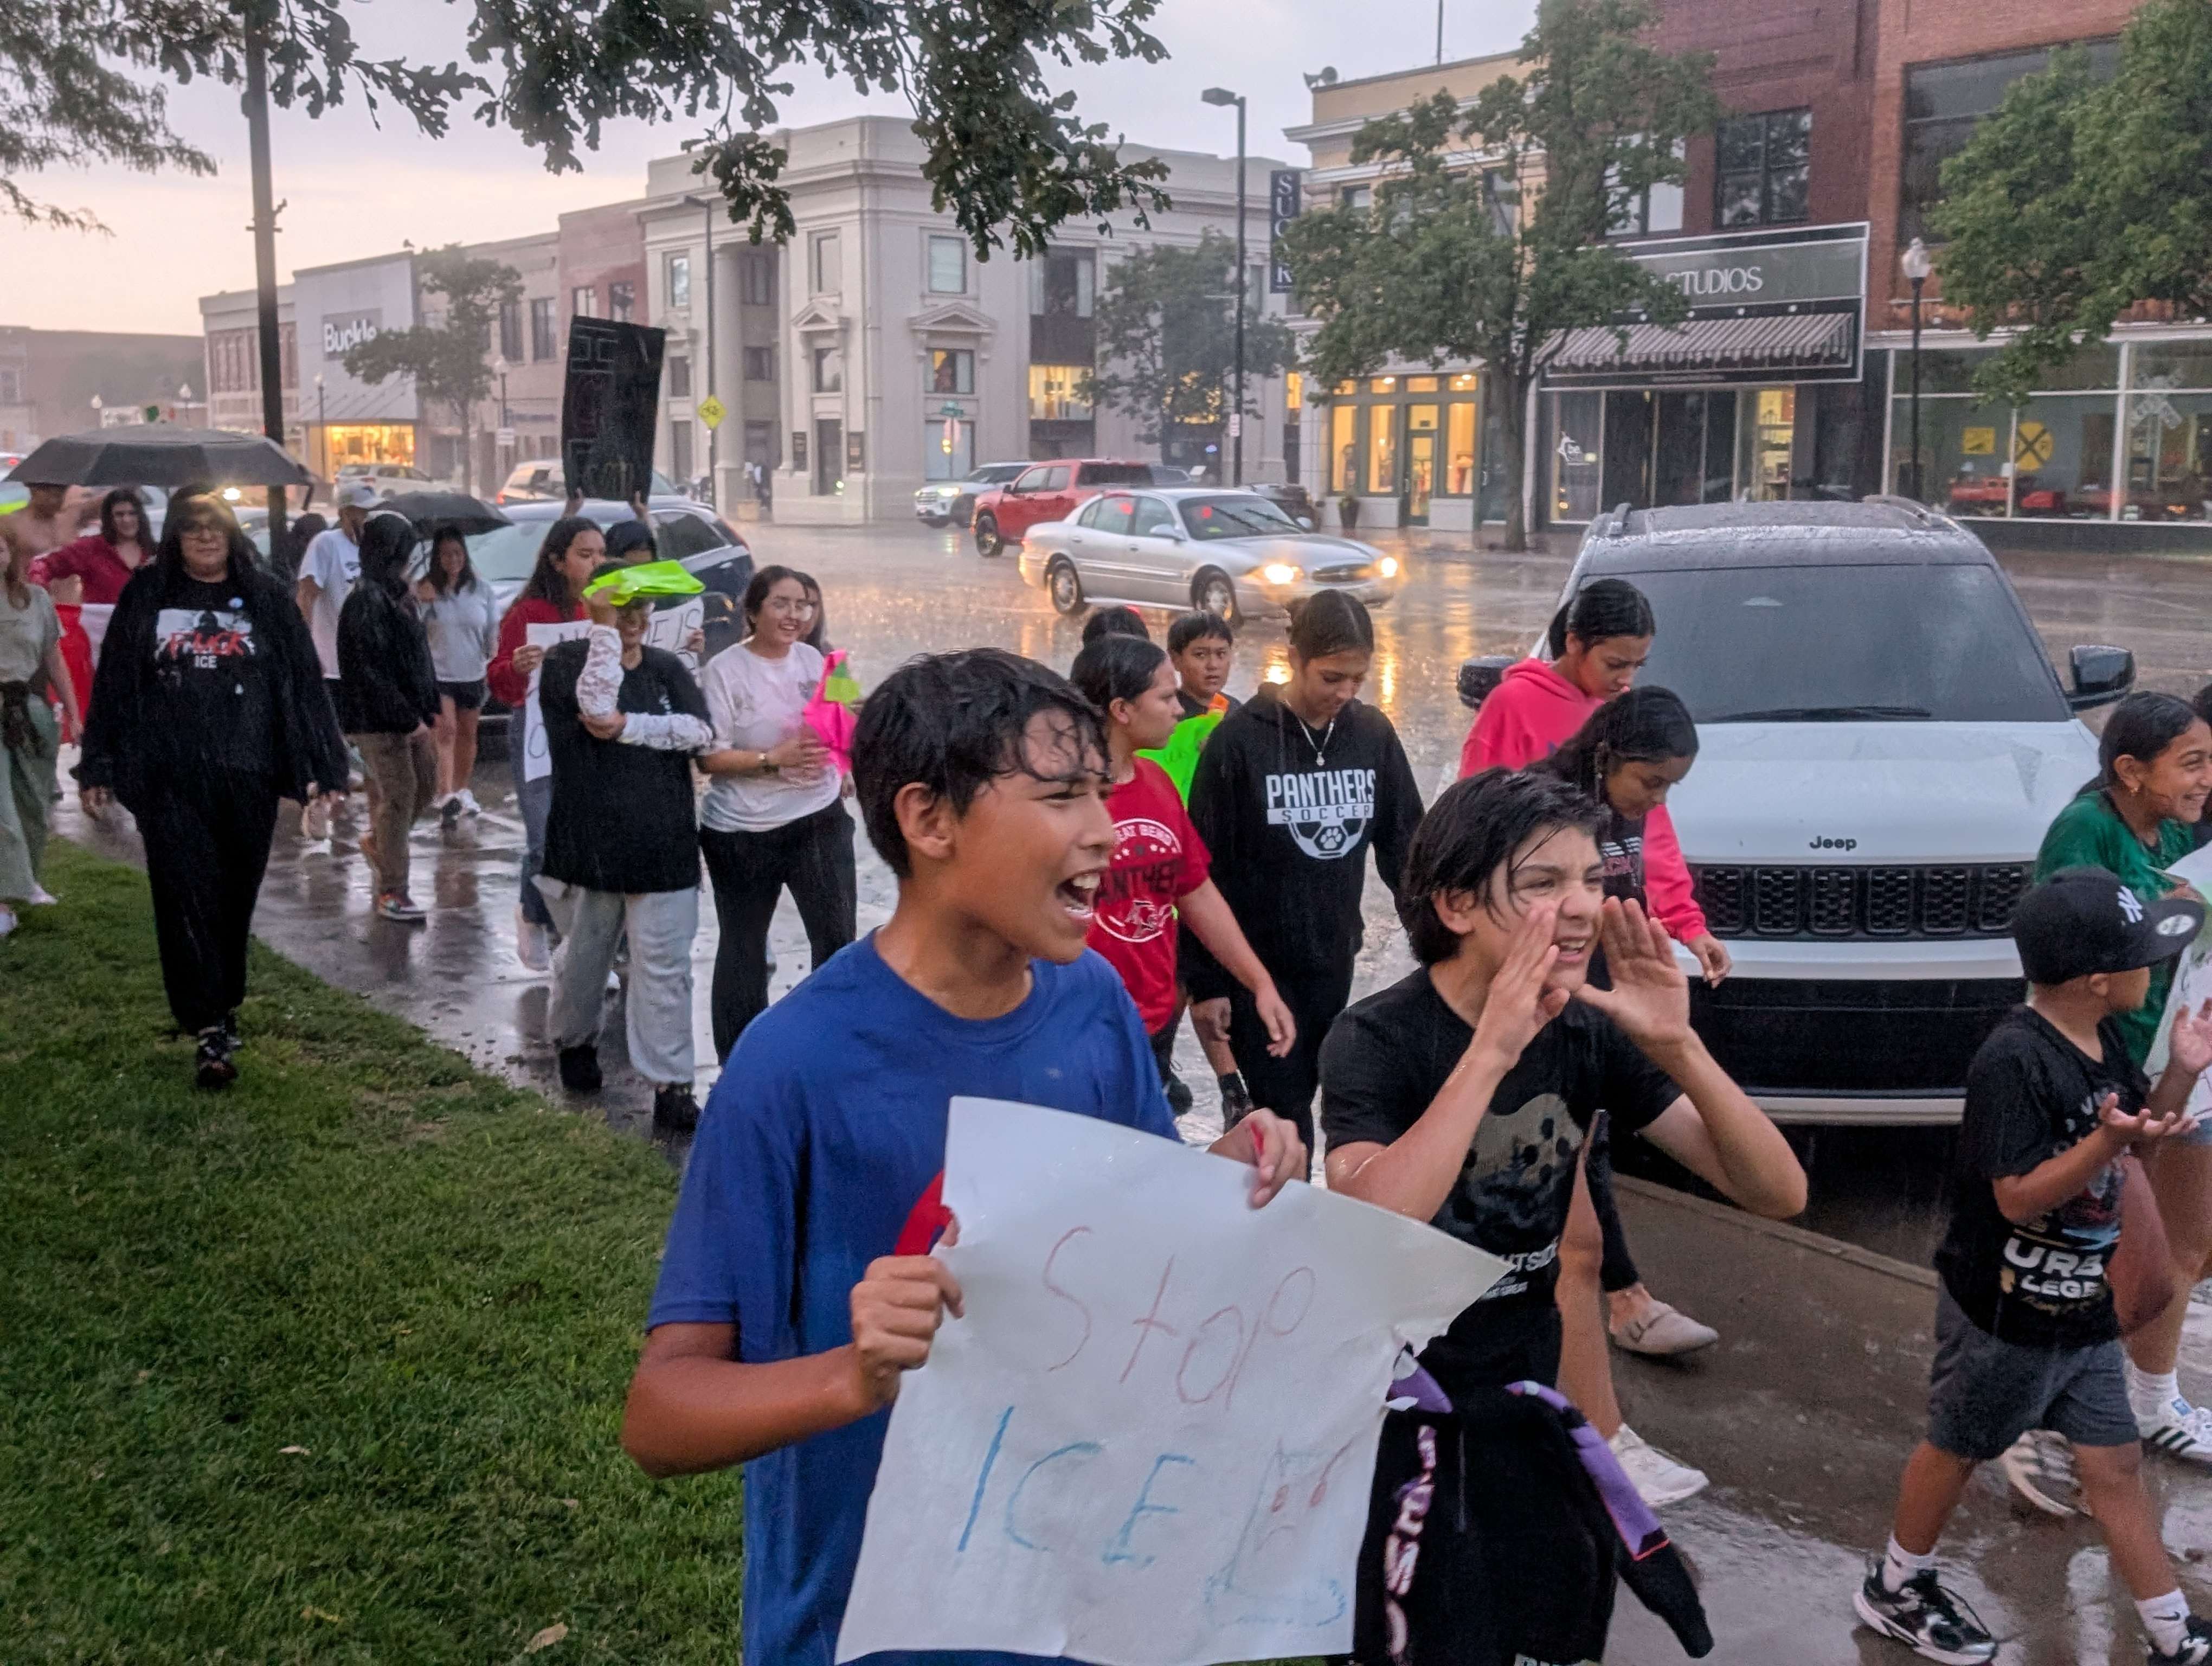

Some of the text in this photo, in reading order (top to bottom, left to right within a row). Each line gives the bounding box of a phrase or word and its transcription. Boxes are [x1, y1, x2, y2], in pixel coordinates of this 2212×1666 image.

[194, 655, 217, 669] ICE
[1265, 769, 1376, 808] PANTHERS
[1282, 805, 1370, 822] SOCCER
[1809, 836, 1857, 851] Jeep
[1043, 1226, 1316, 1411] Stop
[956, 1405, 1195, 1566] ICE
